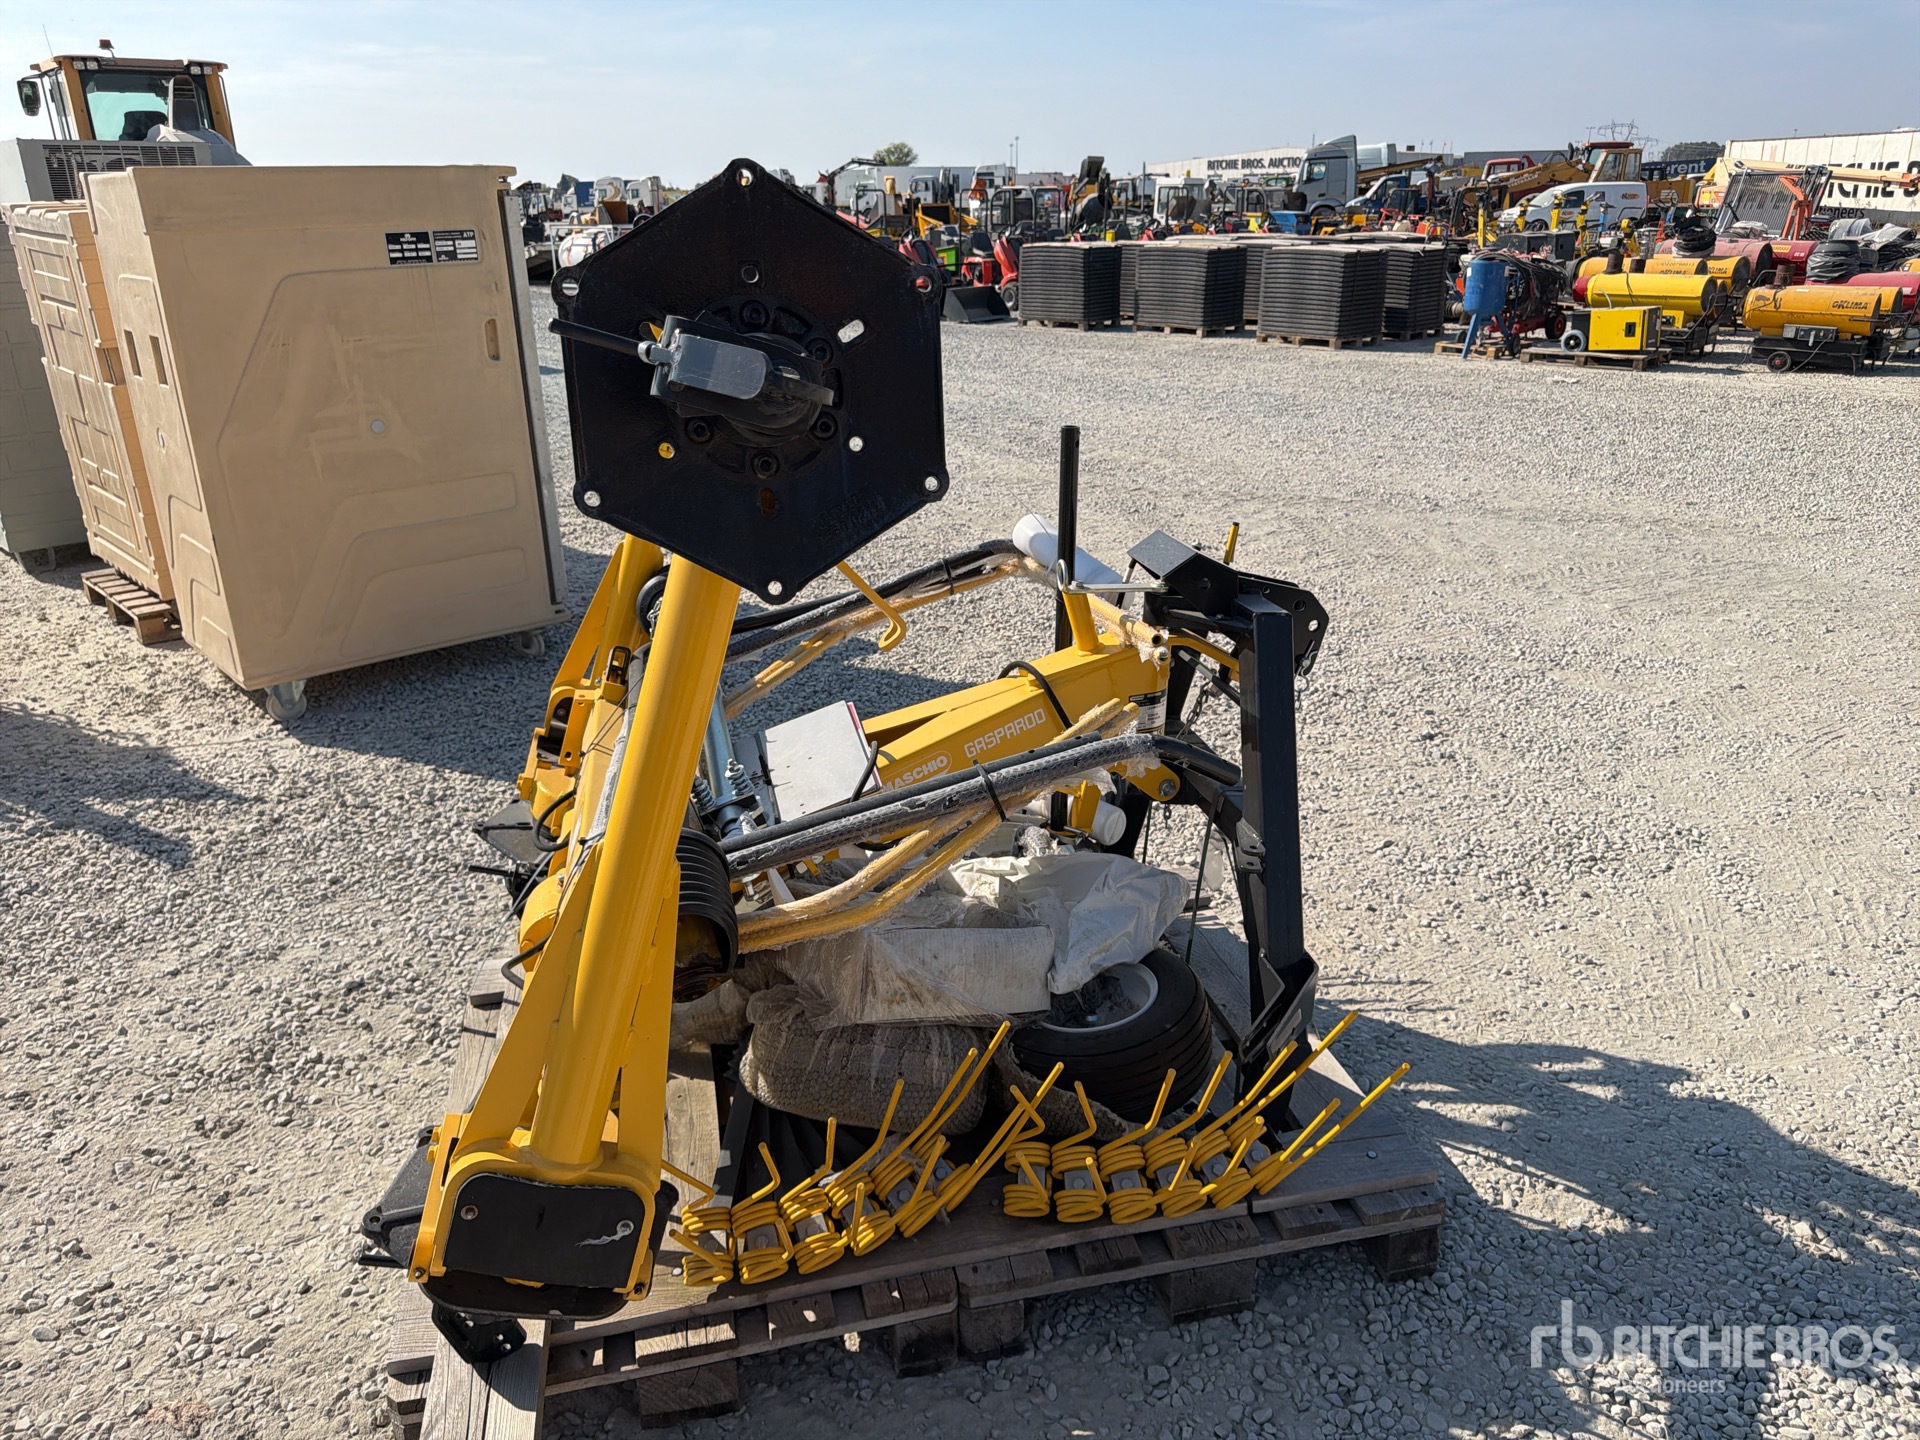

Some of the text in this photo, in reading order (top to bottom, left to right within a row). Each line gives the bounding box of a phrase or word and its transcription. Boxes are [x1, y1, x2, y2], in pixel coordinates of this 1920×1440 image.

[1207, 156, 1303, 171] RITCHIE BROS. AUCTIO
[882, 708, 1047, 792] MASCHIO GASPARDO
